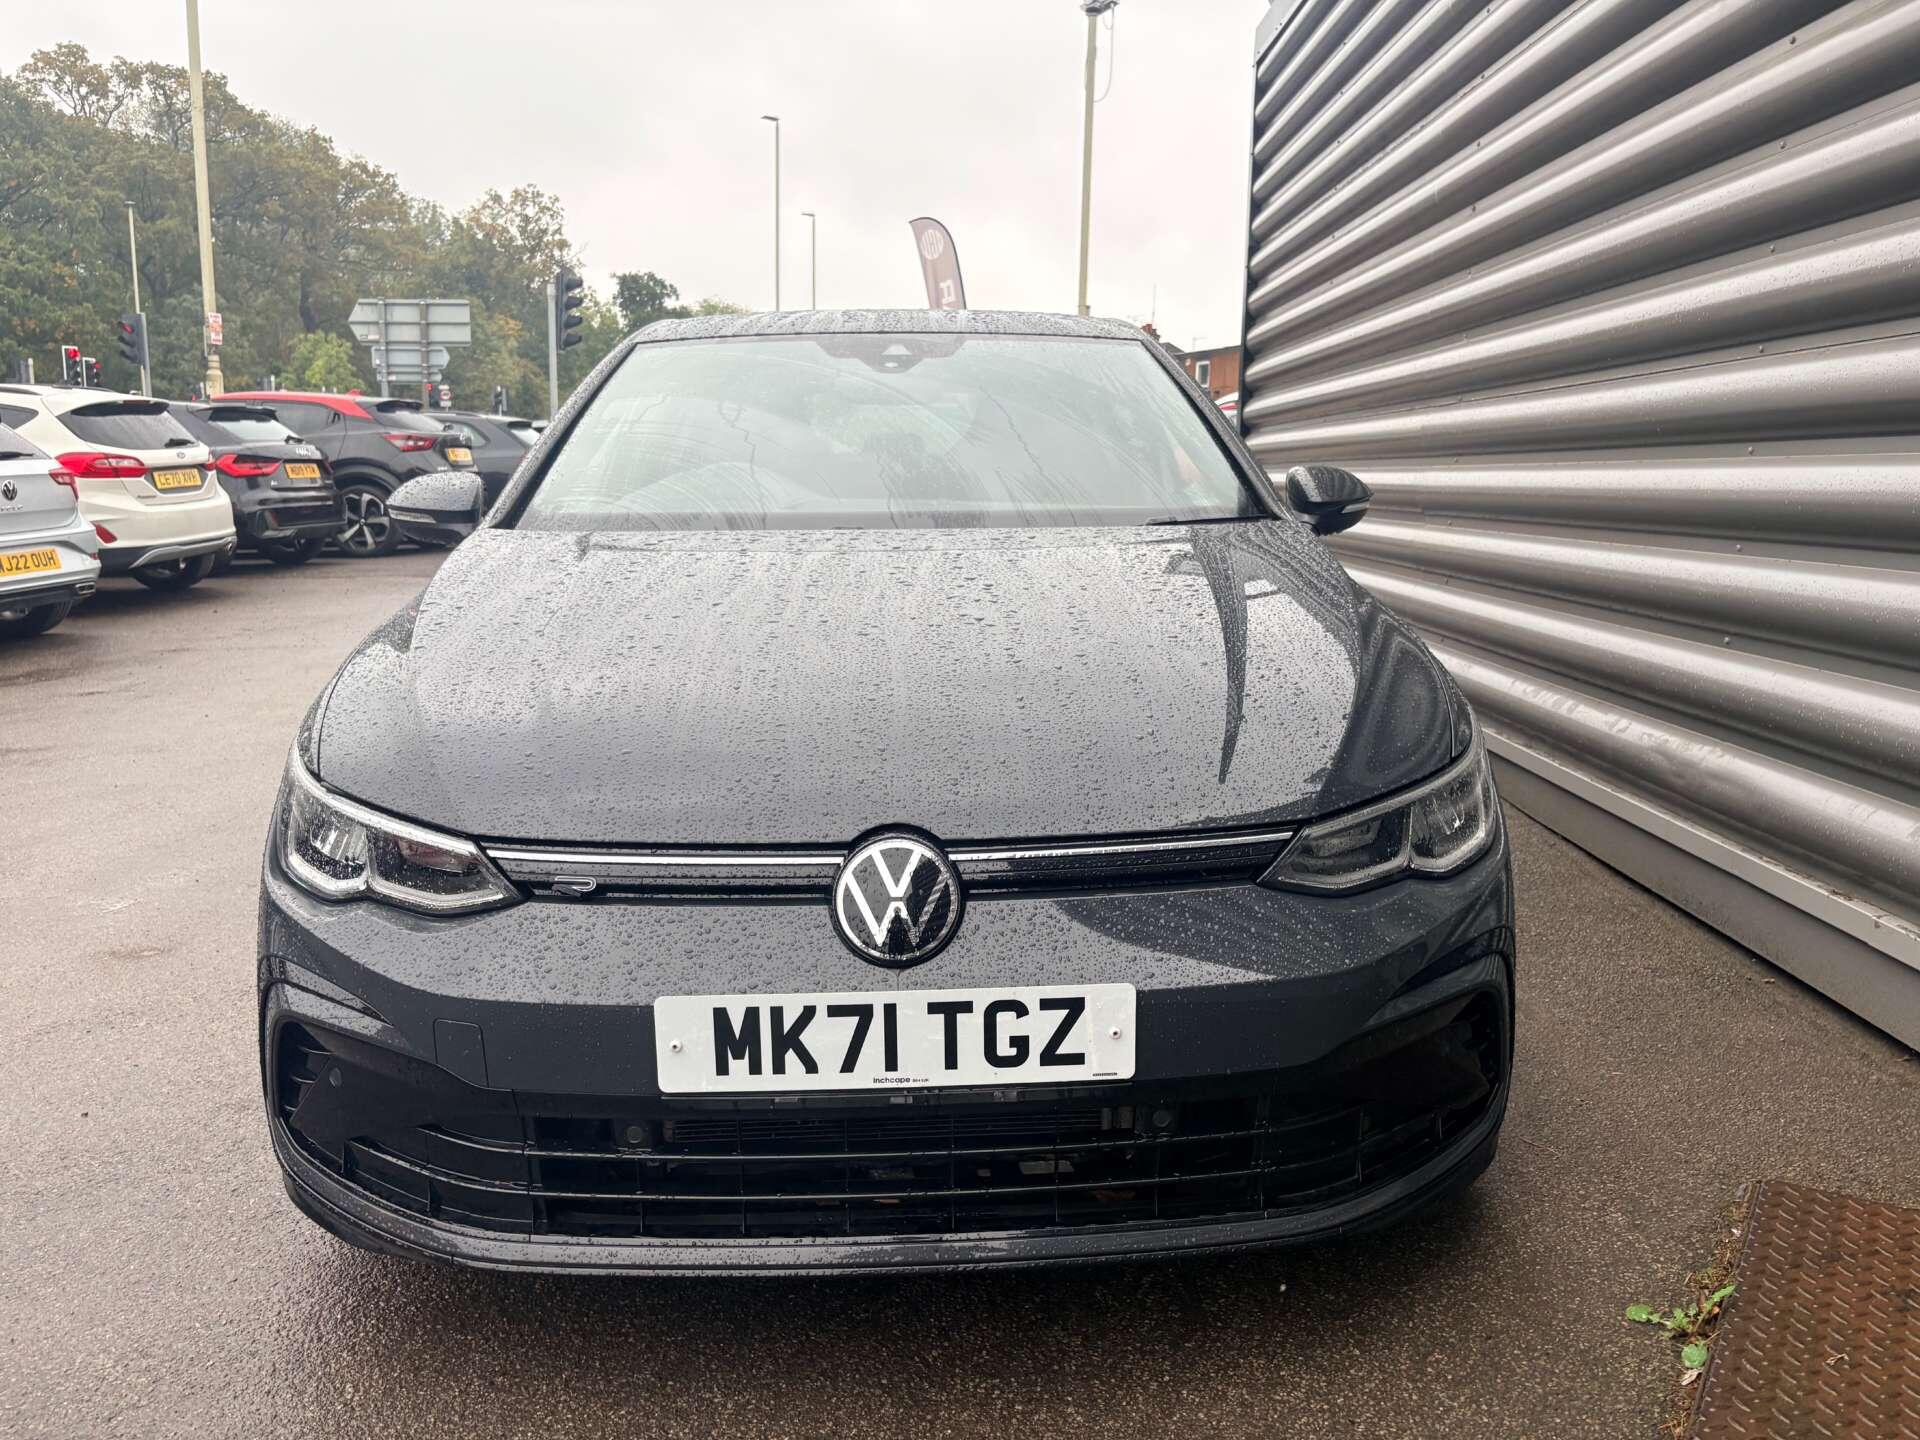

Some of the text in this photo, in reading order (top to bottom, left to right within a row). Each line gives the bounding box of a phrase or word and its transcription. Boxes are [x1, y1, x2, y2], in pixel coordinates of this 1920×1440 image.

[712, 996, 1086, 1076] MK71 TGZ
[872, 1076, 911, 1084] inchcape
